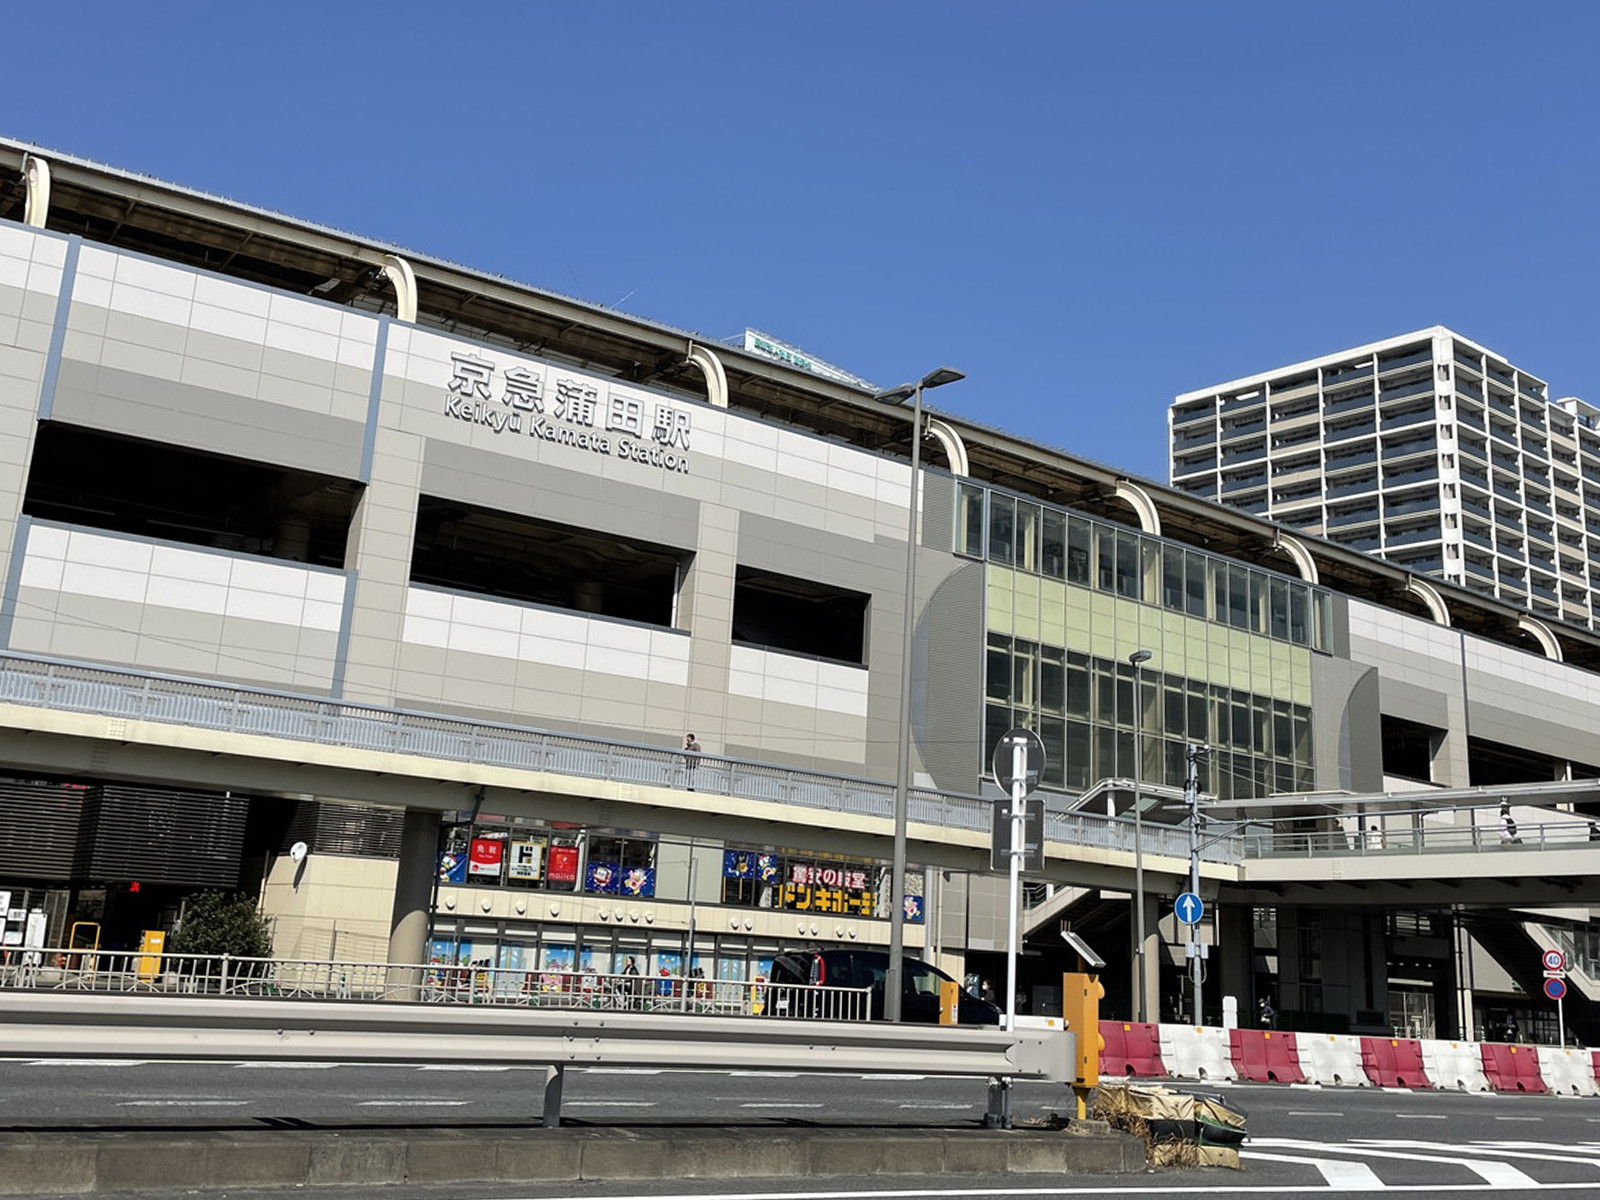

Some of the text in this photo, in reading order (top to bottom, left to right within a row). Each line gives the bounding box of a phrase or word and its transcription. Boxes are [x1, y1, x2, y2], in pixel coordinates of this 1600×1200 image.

[444, 394, 690, 474] Keikyū Kamata Station
[448, 351, 691, 449] 京急蒲田駅
[1548, 955, 1559, 965] 40
